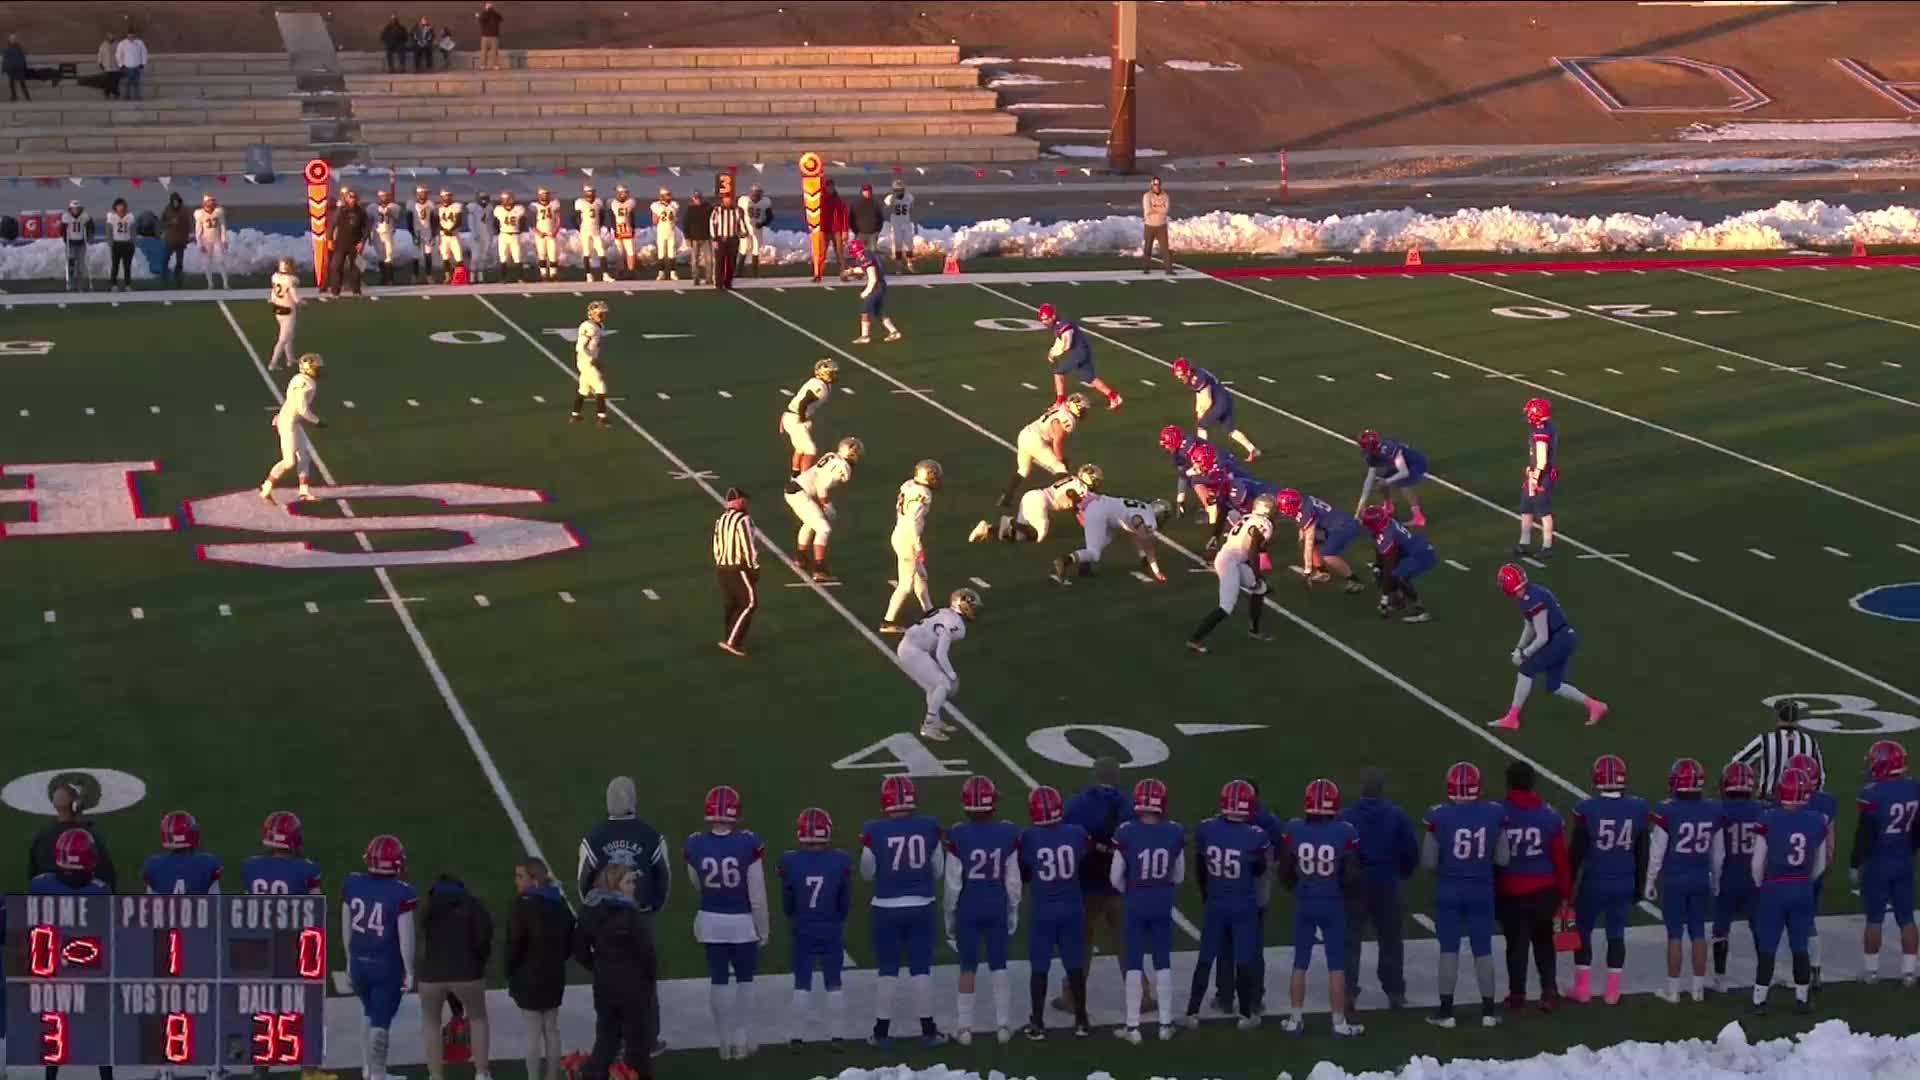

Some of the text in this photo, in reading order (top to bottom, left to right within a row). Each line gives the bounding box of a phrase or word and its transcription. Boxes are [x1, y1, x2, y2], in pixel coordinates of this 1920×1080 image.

[1885, 800, 1920, 836] 27
[1453, 827, 1487, 860] 61
[1506, 827, 1543, 857] 72
[1597, 819, 1634, 851] 54
[1675, 822, 1714, 854] 25
[1728, 822, 1756, 854] 15
[1787, 832, 1806, 866] 3
[887, 834, 926, 871] 70
[968, 848, 1003, 881] 21
[1037, 844, 1075, 881] 30
[1137, 847, 1169, 880] 10
[1206, 845, 1241, 879] 35
[1299, 843, 1335, 876] 88
[702, 857, 741, 889] 26
[806, 876, 824, 908] 7
[351, 898, 384, 937] 24
